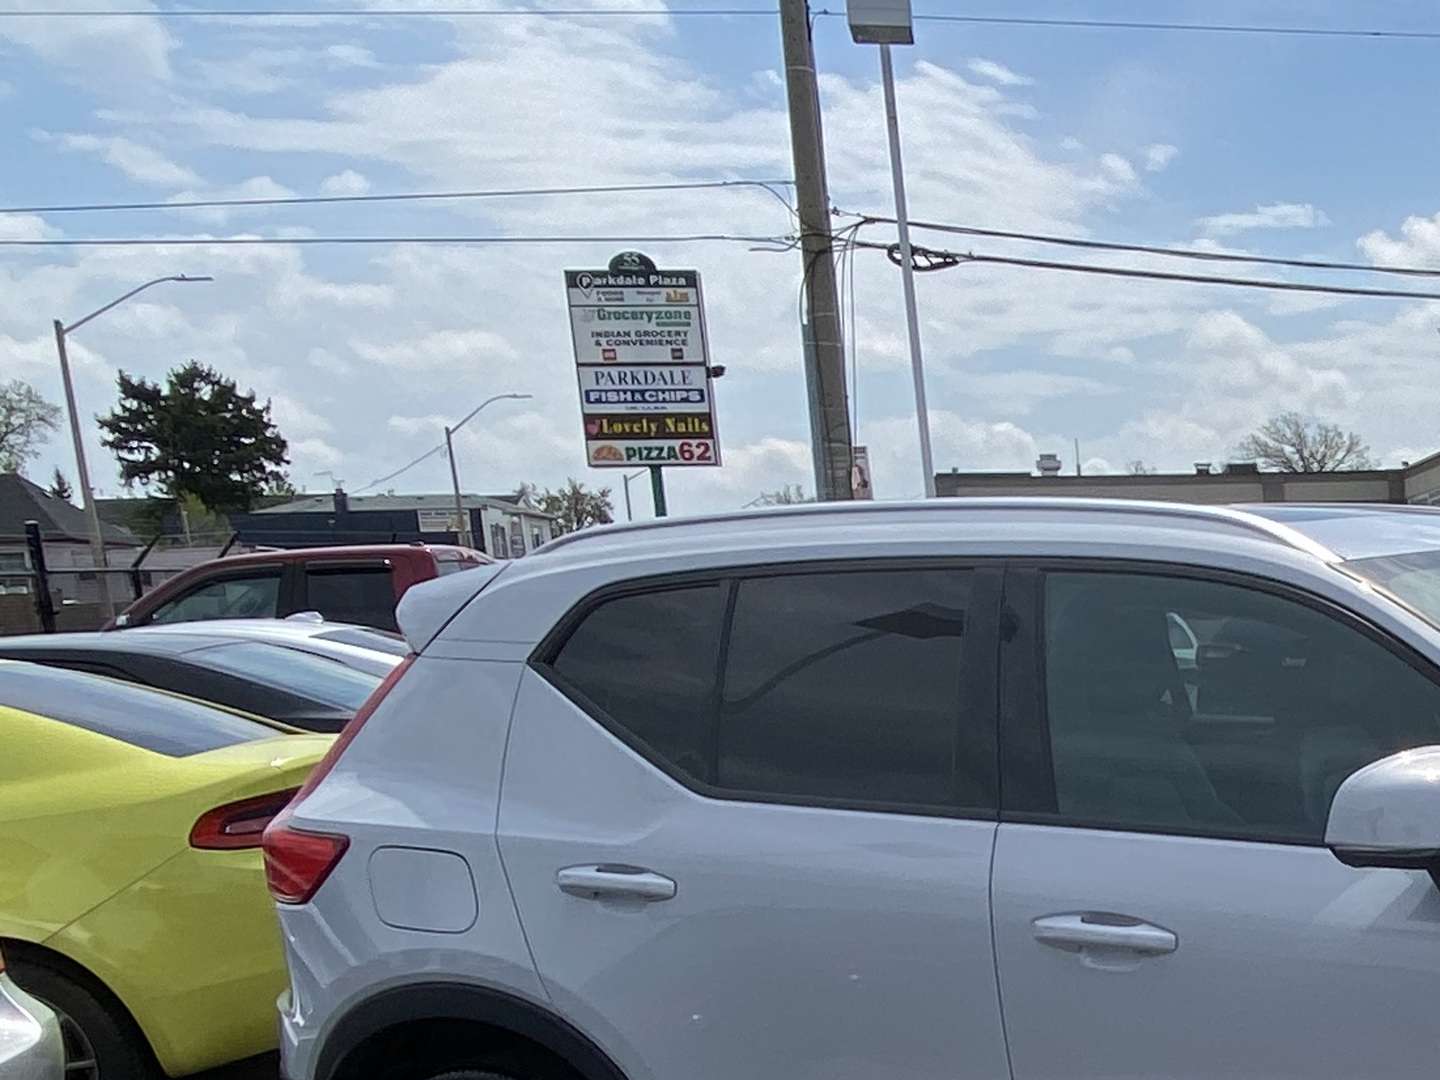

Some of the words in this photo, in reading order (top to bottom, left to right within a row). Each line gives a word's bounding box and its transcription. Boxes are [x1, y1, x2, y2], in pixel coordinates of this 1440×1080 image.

[581, 274, 646, 287] Parkdale
[649, 274, 687, 286] Plaza
[591, 330, 632, 339] INDIAN
[634, 329, 689, 338] GROCERY
[606, 339, 689, 347] CONVENIENCE
[593, 369, 693, 386] PARKDALE
[589, 390, 632, 402] FISH
[633, 393, 643, 402] &
[644, 390, 702, 402] CHIPS
[602, 417, 659, 437] Lovely
[664, 416, 710, 433] Nails
[625, 445, 679, 461] PIZZA
[679, 441, 712, 461] 62
